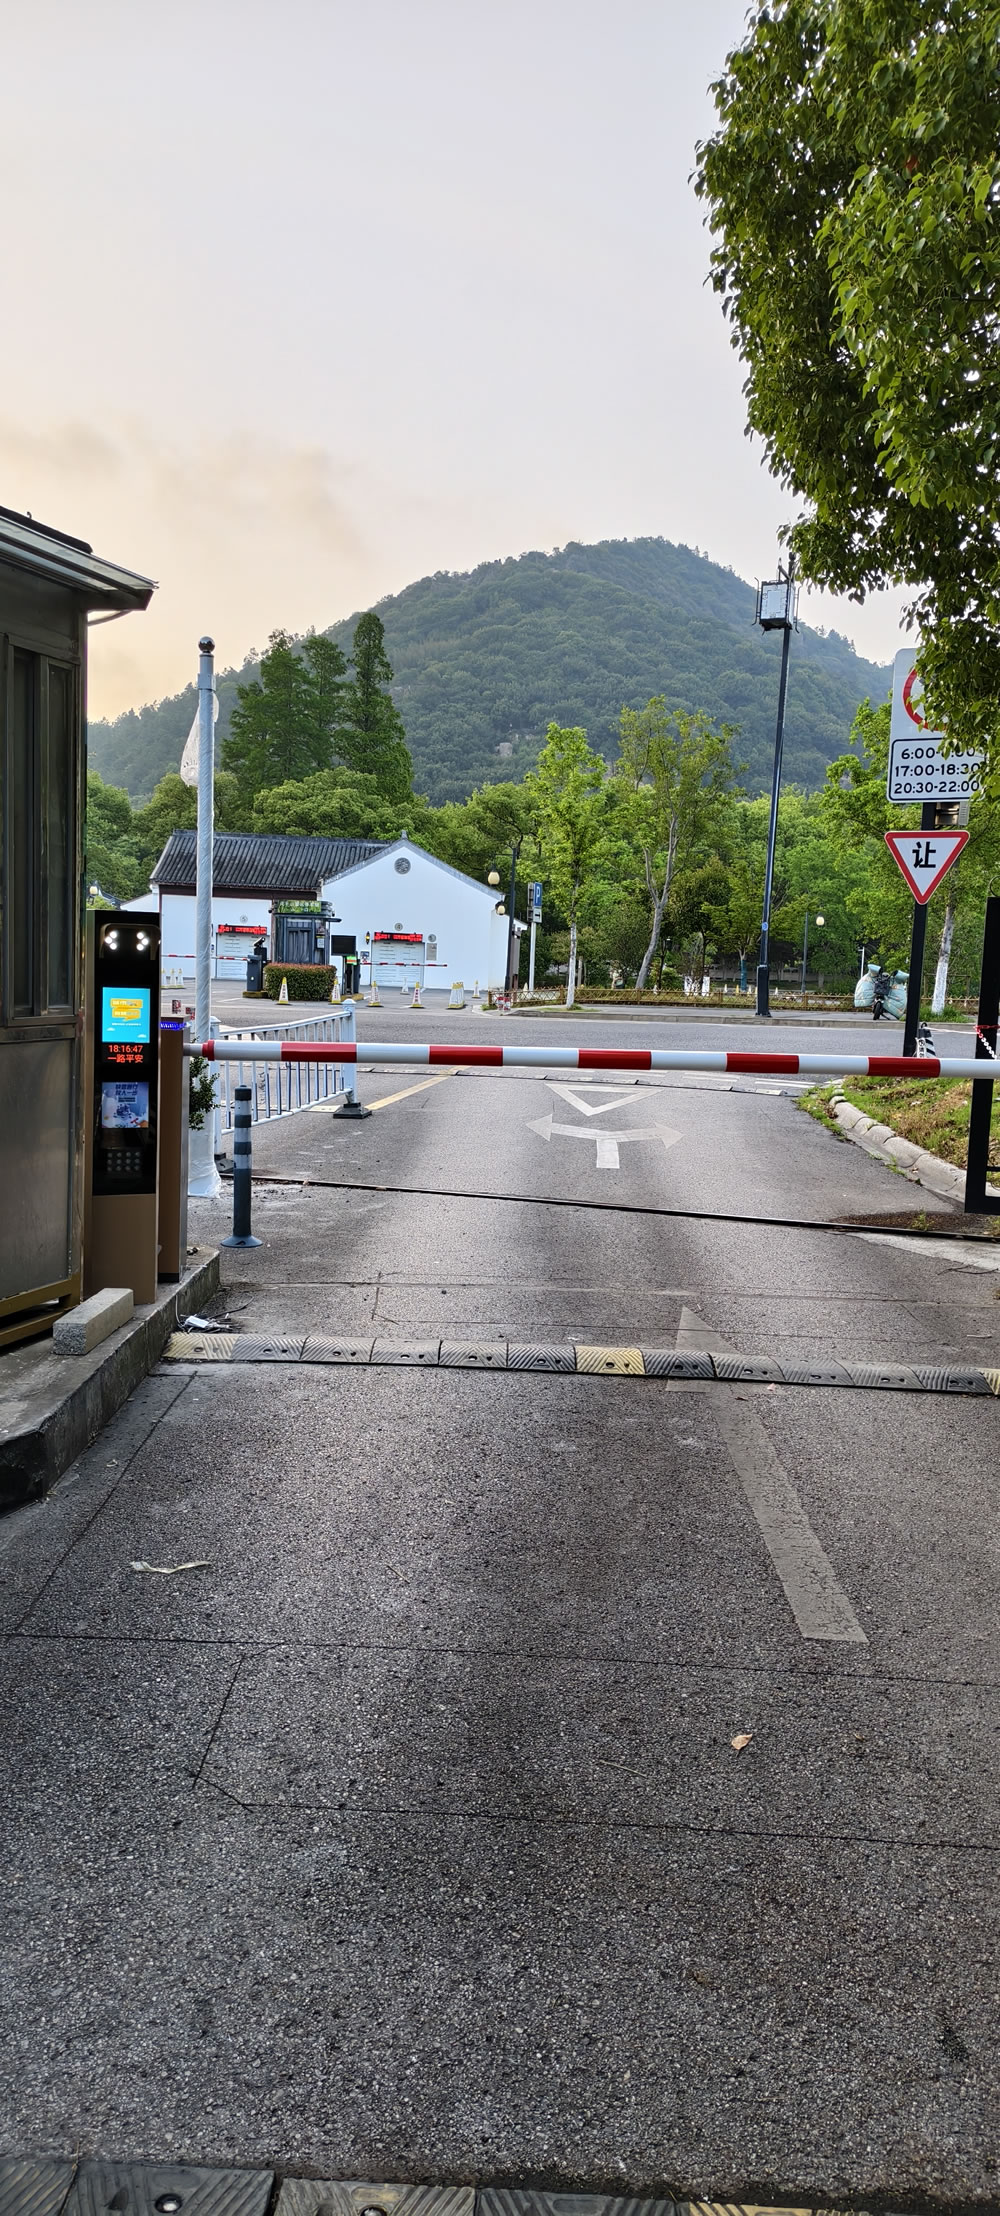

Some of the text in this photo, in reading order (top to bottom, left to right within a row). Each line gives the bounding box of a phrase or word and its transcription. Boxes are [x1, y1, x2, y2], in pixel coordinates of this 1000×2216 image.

[901, 747, 975, 760] 6:00-:0
[895, 763, 980, 777] 17:00-18:30
[894, 781, 979, 794] 20:30-22:00
[912, 841, 936, 868] 让
[108, 1045, 143, 1053] 18:16:47
[107, 1054, 144, 1063] 一路平安
